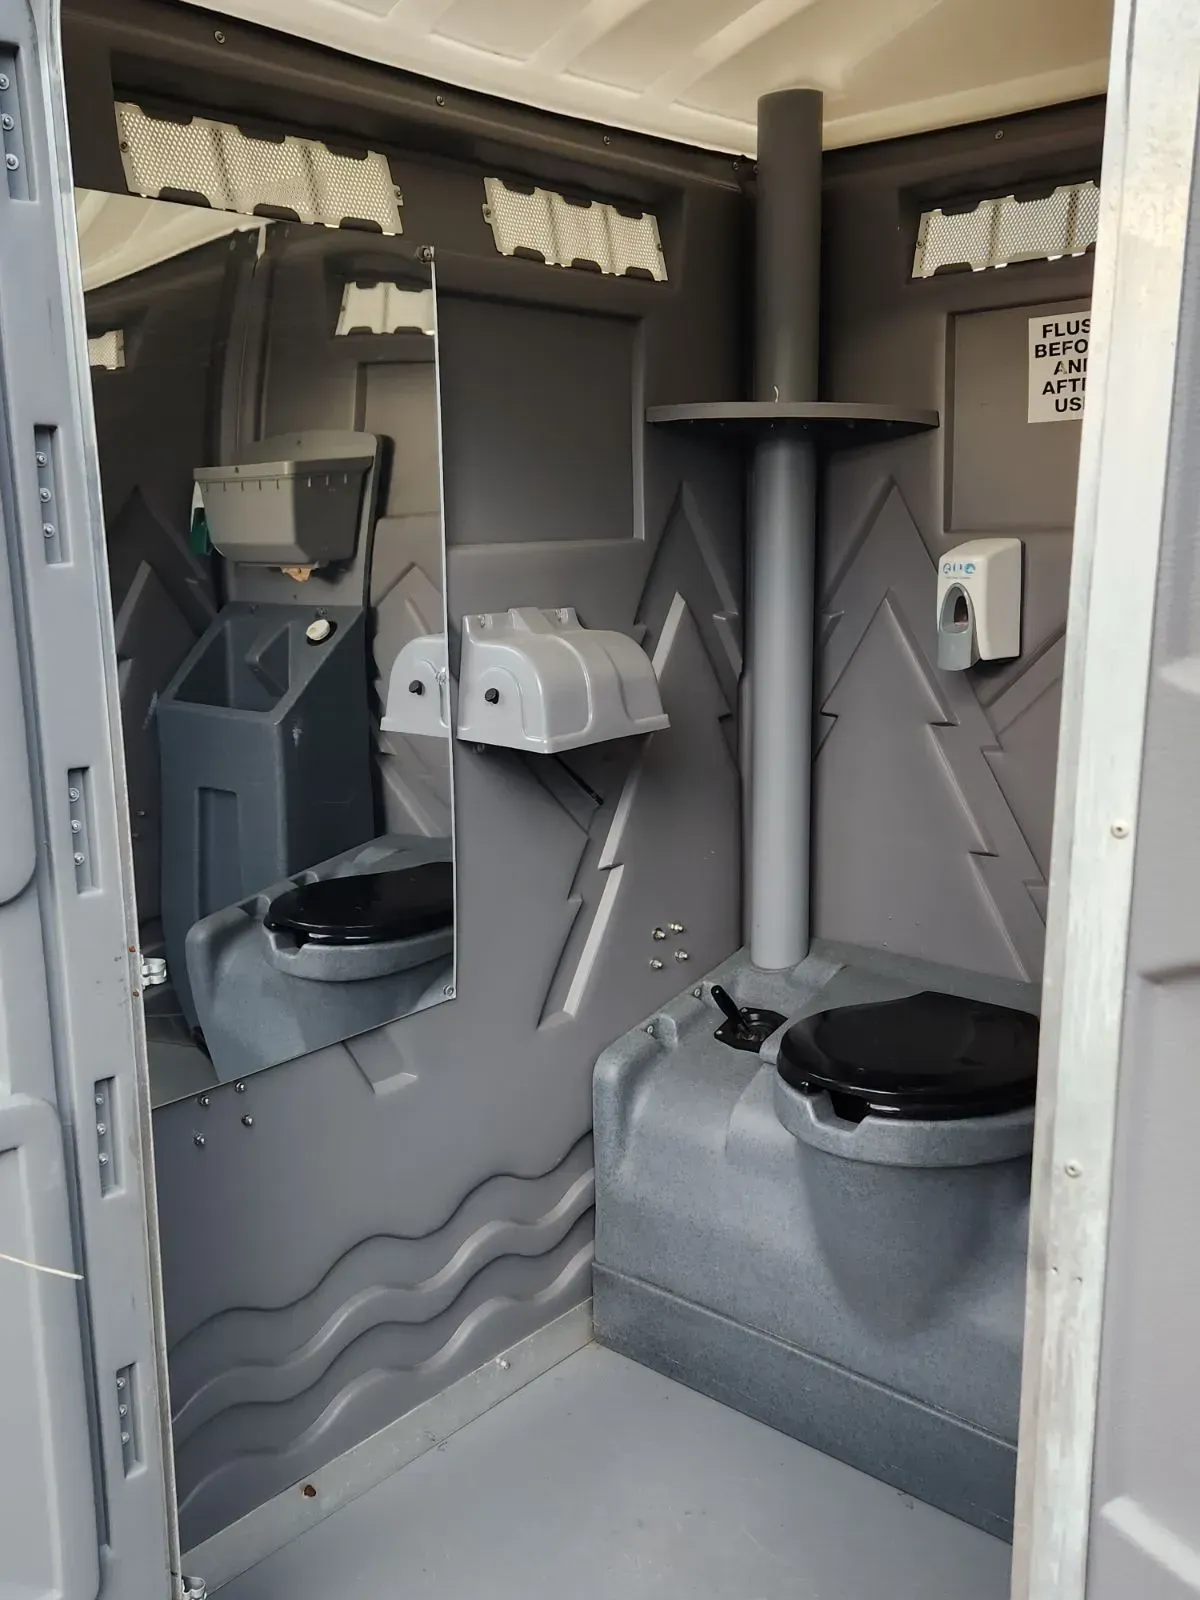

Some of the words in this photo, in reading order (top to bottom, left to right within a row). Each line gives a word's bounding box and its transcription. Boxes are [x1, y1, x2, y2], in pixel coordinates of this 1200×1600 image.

[1042, 319, 1091, 338] FLUS
[1035, 339, 1089, 358] BEFO
[1042, 377, 1086, 395] AFT
[1055, 396, 1085, 412] US
